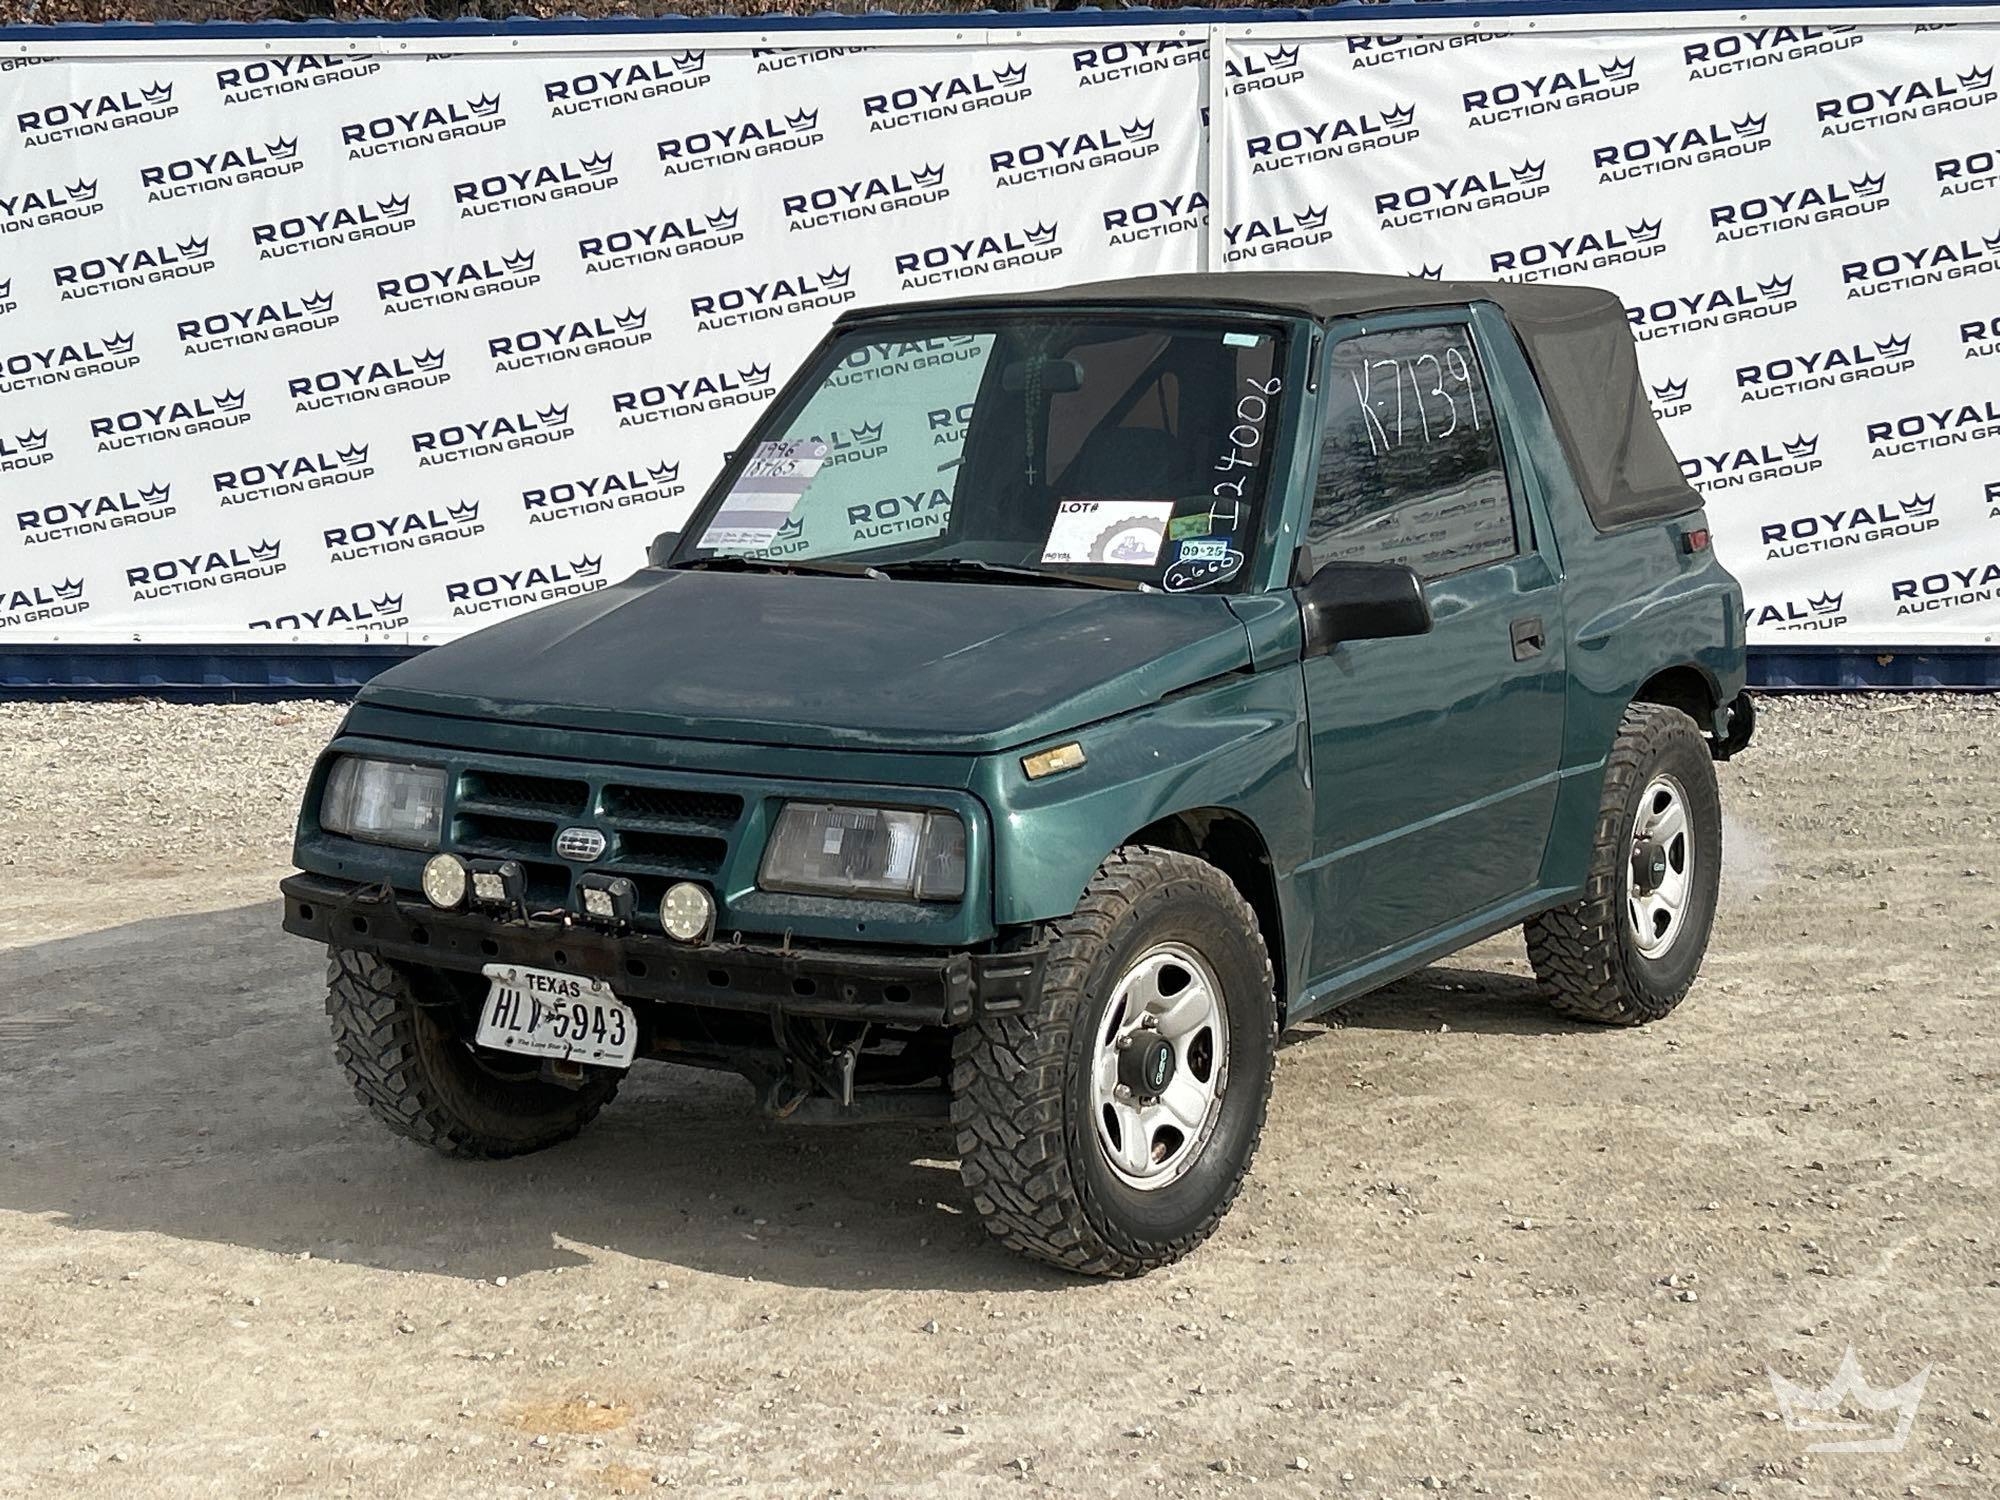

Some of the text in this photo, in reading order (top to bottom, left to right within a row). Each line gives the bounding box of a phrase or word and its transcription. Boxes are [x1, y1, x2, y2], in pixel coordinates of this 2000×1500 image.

[757, 48, 845, 74] AUCTION
[1079, 57, 1169, 88] AUCTION
[1352, 39, 1445, 70] AUCTION
[1689, 35, 1864, 82] AUCTION GROUP
[224, 63, 381, 106] AUCTION GROUP
[544, 60, 674, 103] ROYAL
[551, 74, 711, 118] AUCTION GROUP
[863, 73, 995, 117] ROYAL
[1232, 70, 1304, 95] GROUP
[1462, 68, 1600, 113] ROYAL
[1816, 76, 1958, 122] ROYAL
[16, 91, 143, 133] ROYAL
[341, 104, 469, 146] ROYAL
[870, 88, 1032, 133] AUCTION GROUP
[1468, 82, 1640, 128] AUCTION GROUP
[1821, 91, 1998, 138] AUCTION GROUP
[24, 106, 179, 149] AUCTION GROUP
[348, 118, 506, 161] AUCTION GROUP
[656, 118, 787, 161] ROYAL
[1246, 114, 1381, 159] ROYAL
[1593, 124, 1732, 169] ROYAL
[140, 146, 267, 188] ROYAL
[664, 133, 824, 177] AUCTION GROUP
[989, 129, 1122, 173] ROYAL
[996, 143, 1160, 189] AUCTION GROUP
[1252, 129, 1420, 175] AUCTION GROUP
[1598, 138, 1772, 185] AUCTION GROUP
[148, 161, 304, 203] AUCTION GROUP
[453, 162, 582, 204] ROYAL
[460, 176, 619, 219] AUCTION GROUP
[782, 174, 913, 217] ROYAL
[1374, 170, 1511, 215] ROYAL
[37, 203, 104, 226] GROUP
[252, 204, 380, 246] ROYAL
[789, 188, 950, 232] AUCTION GROUP
[1381, 185, 1550, 230] AUCTION GROUP
[1710, 183, 1850, 227] ROYAL
[1715, 198, 1890, 244] AUCTION GROUP
[259, 219, 416, 261] AUCTION GROUP
[578, 218, 707, 259] ROYAL
[1109, 217, 1199, 247] AUCTION
[1261, 231, 1333, 255] GROUP
[1490, 229, 1627, 273] ROYAL
[53, 246, 179, 287] ROYAL
[585, 232, 744, 275] AUCTION GROUP
[895, 232, 1025, 275] ROYAL
[901, 247, 1063, 291] AUCTION GROUP
[1592, 244, 1666, 269] GROUP
[1841, 240, 1983, 284] ROYAL
[61, 260, 215, 302] AUCTION GROUP
[376, 260, 504, 301] ROYAL
[384, 274, 541, 316] AUCTION GROUP
[690, 276, 819, 318] ROYAL
[1847, 270, 1943, 300] AUCTION
[176, 301, 303, 341] ROYAL
[697, 290, 856, 333] AUCTION GROUP
[1723, 300, 1797, 325] GROUP
[184, 315, 340, 356] AUCTION GROUP
[488, 318, 616, 358] ROYAL
[495, 332, 652, 373] AUCTION GROUP
[73, 356, 140, 378] GROUP
[287, 358, 414, 398] ROYAL
[912, 346, 982, 370] GROUP
[1735, 344, 1875, 387] ROYAL
[295, 373, 451, 413] AUCTION GROUP
[612, 373, 740, 413] ROYAL
[1741, 359, 1915, 403] AUCTION GROUP
[90, 398, 215, 438] ROYAL
[619, 387, 776, 428] AUCTION GROUP
[1867, 402, 2000, 444] ROYAL
[97, 413, 251, 453] AUCTION GROUP
[411, 413, 538, 453] ROYAL
[419, 428, 575, 468] AUCTION GROUP
[1871, 431, 1967, 460] AUCTION
[212, 453, 339, 492] ROYAL
[819, 445, 888, 471] GROUP
[1748, 459, 1823, 483] GROUP
[220, 467, 375, 507] AUCTION GROUP
[522, 470, 649, 510] ROYAL
[529, 485, 685, 525] AUCTION GROUP
[1060, 502, 1099, 513] LOT#
[16, 492, 141, 531] ROYAL
[24, 506, 176, 546] AUCTION GROUP
[323, 510, 449, 549] ROYAL
[853, 513, 939, 541] AUCTION
[1761, 503, 1900, 545] ROYAL
[331, 524, 485, 563] AUCTION GROUP
[1766, 518, 1940, 561] AUCTION GROUP
[125, 549, 251, 587] ROYAL
[133, 563, 287, 602] AUCTION GROUP
[445, 564, 571, 603] ROYAL
[24, 601, 90, 623] GROUP
[453, 579, 607, 617] AUCTION GROUP
[1896, 589, 1991, 616] AUCTION
[525, 973, 581, 998] TEXAS
